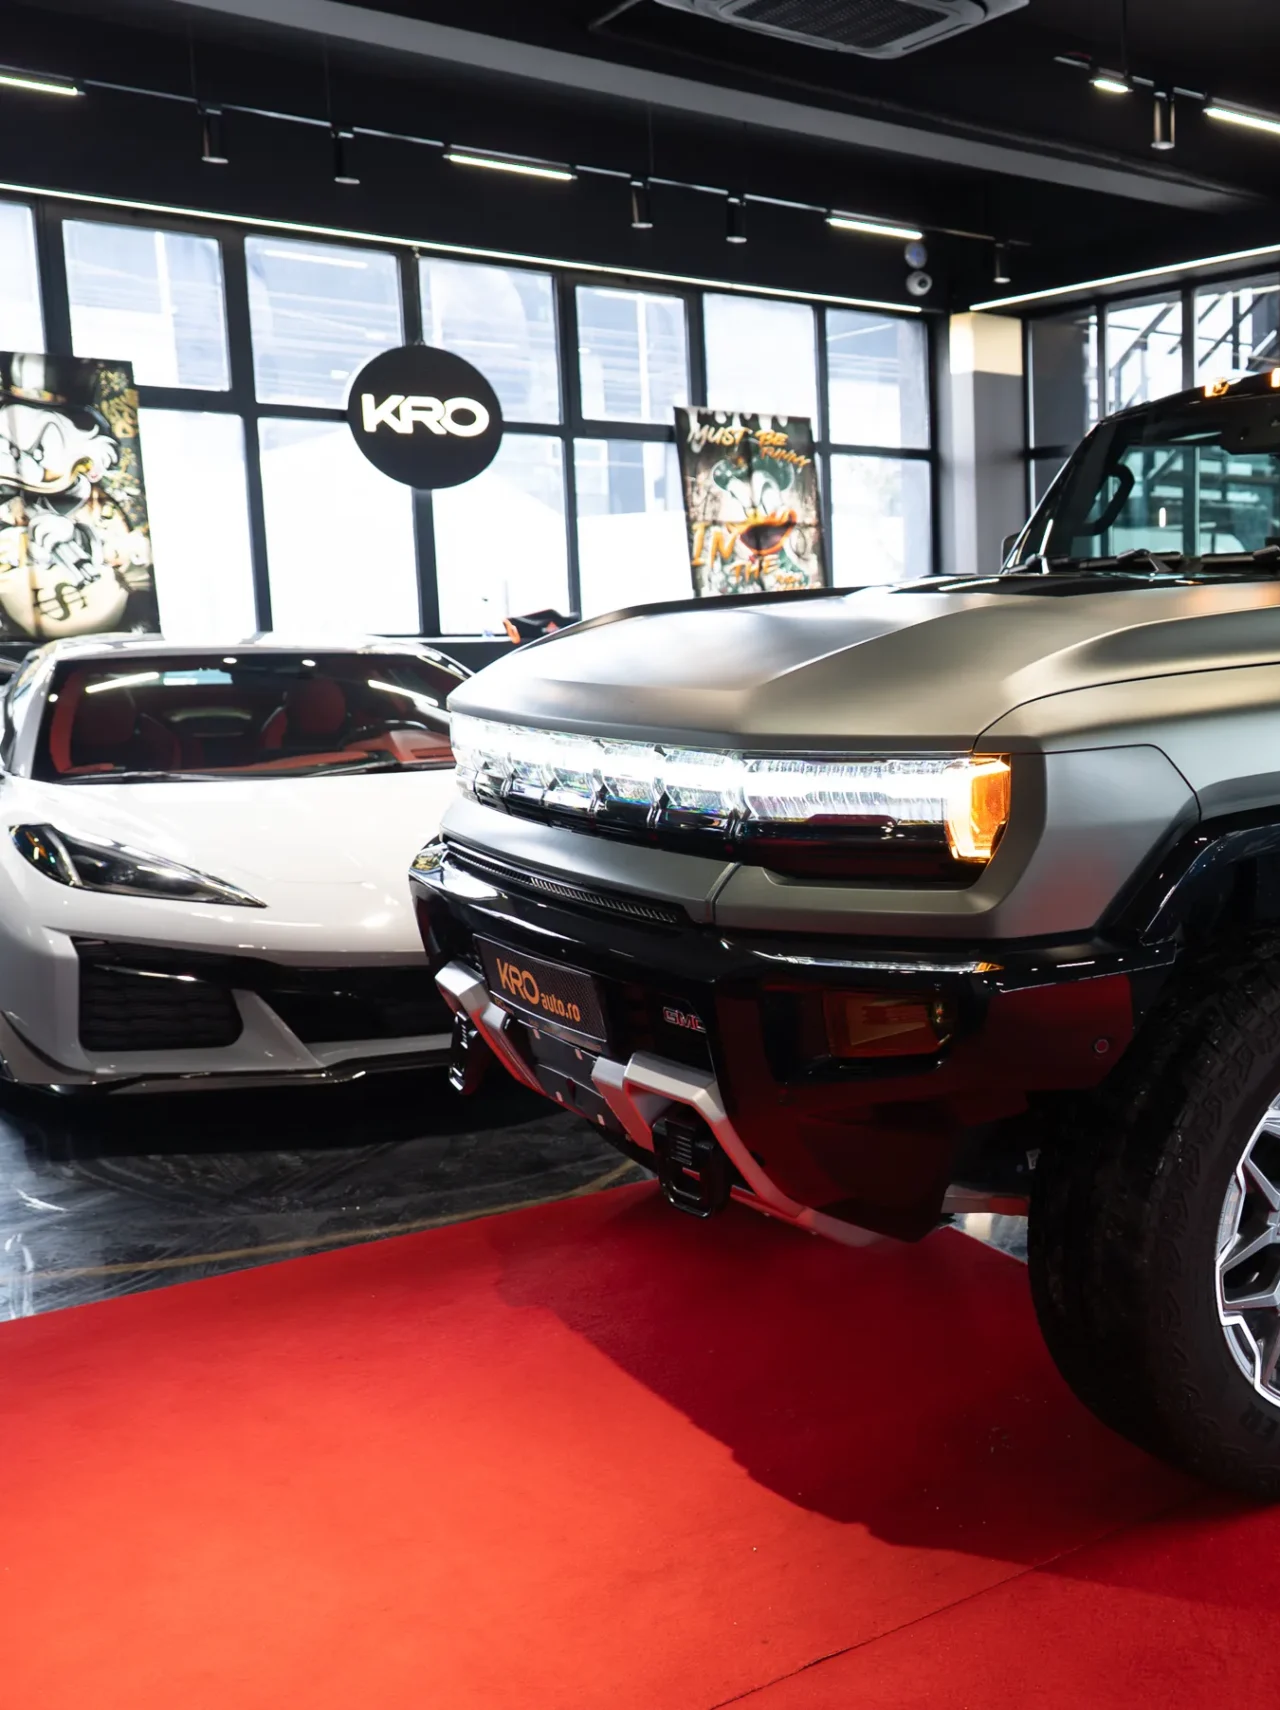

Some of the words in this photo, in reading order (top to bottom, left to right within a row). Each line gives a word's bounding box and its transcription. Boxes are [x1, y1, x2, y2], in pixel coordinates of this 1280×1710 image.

[361, 393, 490, 438] KRO
[687, 424, 751, 449] MUST
[691, 521, 739, 569] IN
[496, 957, 539, 1005] KRO
[540, 992, 581, 1023] auto.ro
